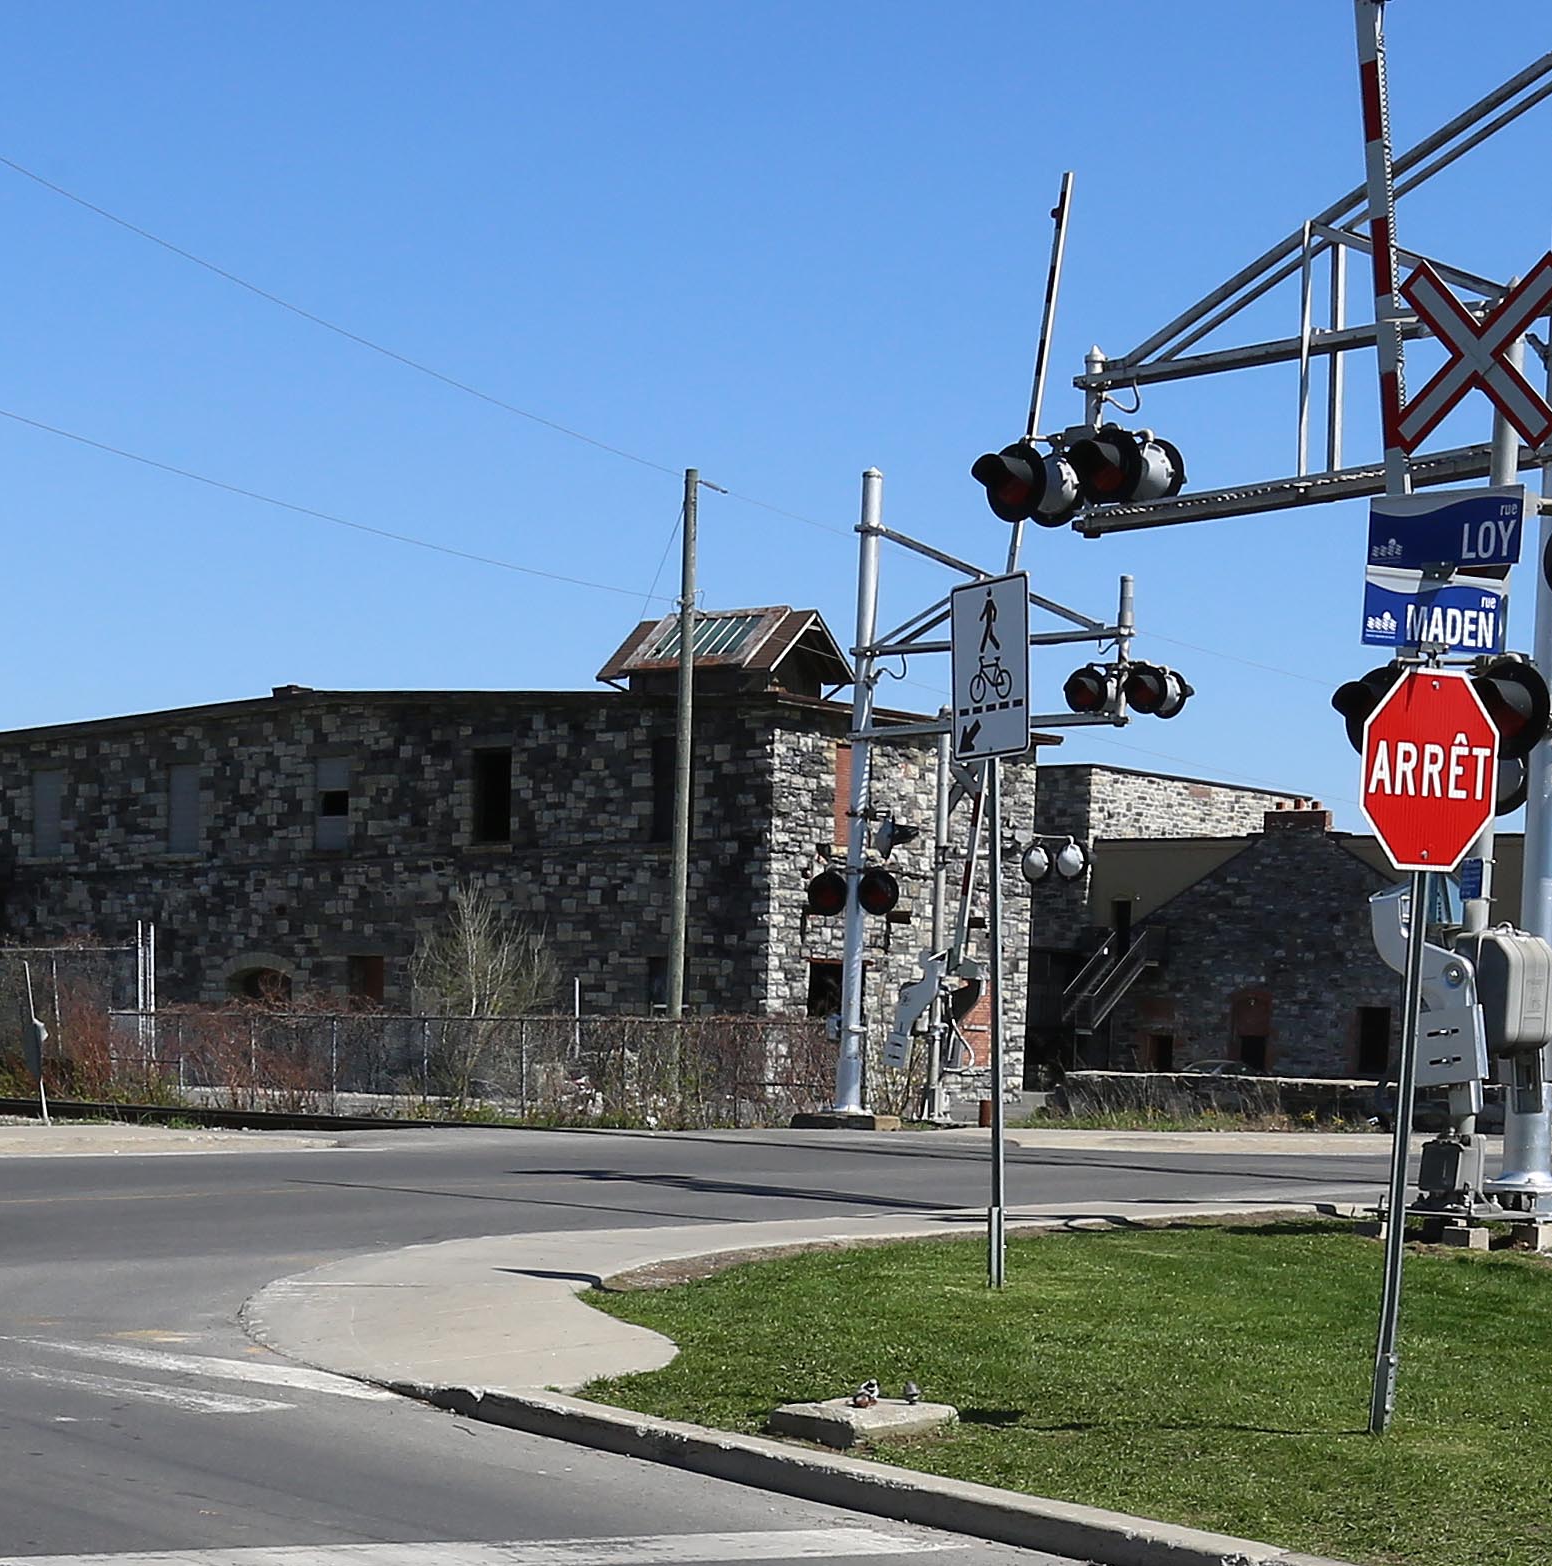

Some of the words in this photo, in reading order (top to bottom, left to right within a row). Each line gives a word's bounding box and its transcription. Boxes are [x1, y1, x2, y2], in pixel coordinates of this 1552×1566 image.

[1500, 503, 1518, 516] rue
[1462, 519, 1517, 560] LOY
[1481, 596, 1497, 610] rue
[1406, 604, 1494, 649] MADEN
[1368, 733, 1491, 800] ARRÊT
